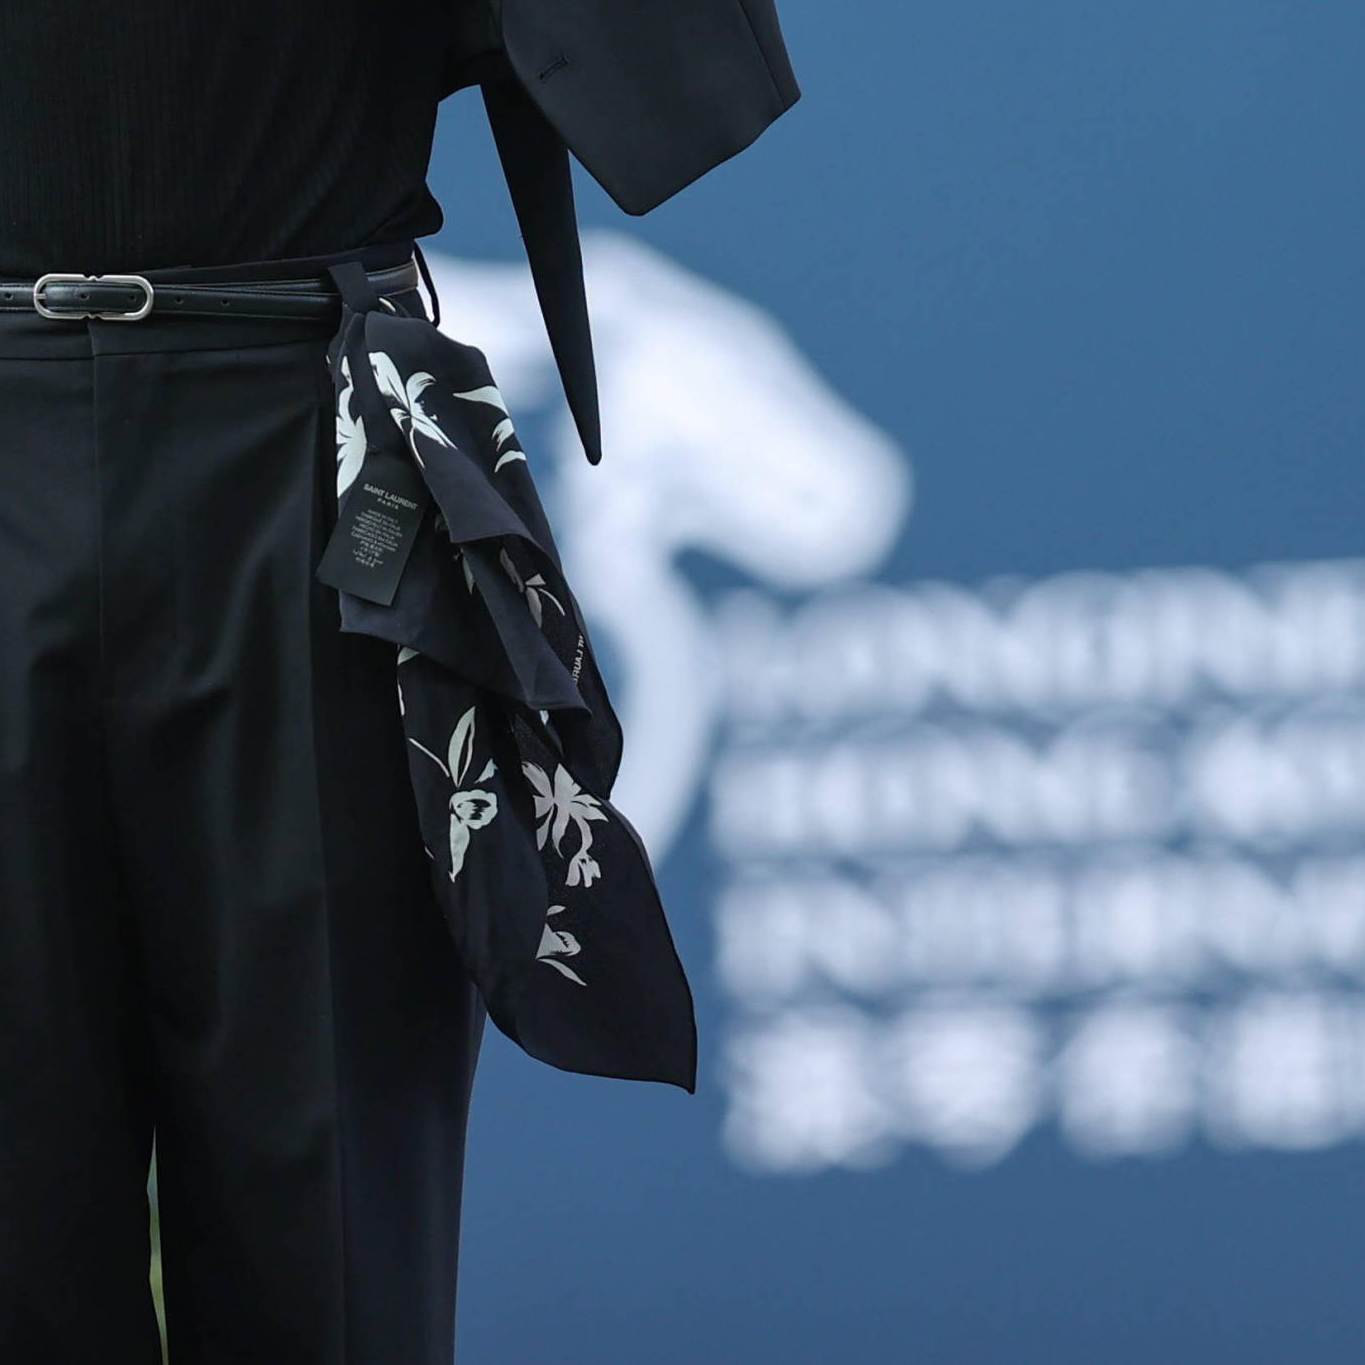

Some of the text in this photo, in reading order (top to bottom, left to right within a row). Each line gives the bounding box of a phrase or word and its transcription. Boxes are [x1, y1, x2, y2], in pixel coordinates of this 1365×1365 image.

[363, 483, 418, 510] SAINT LAURENT
[377, 498, 399, 510] PARIS
